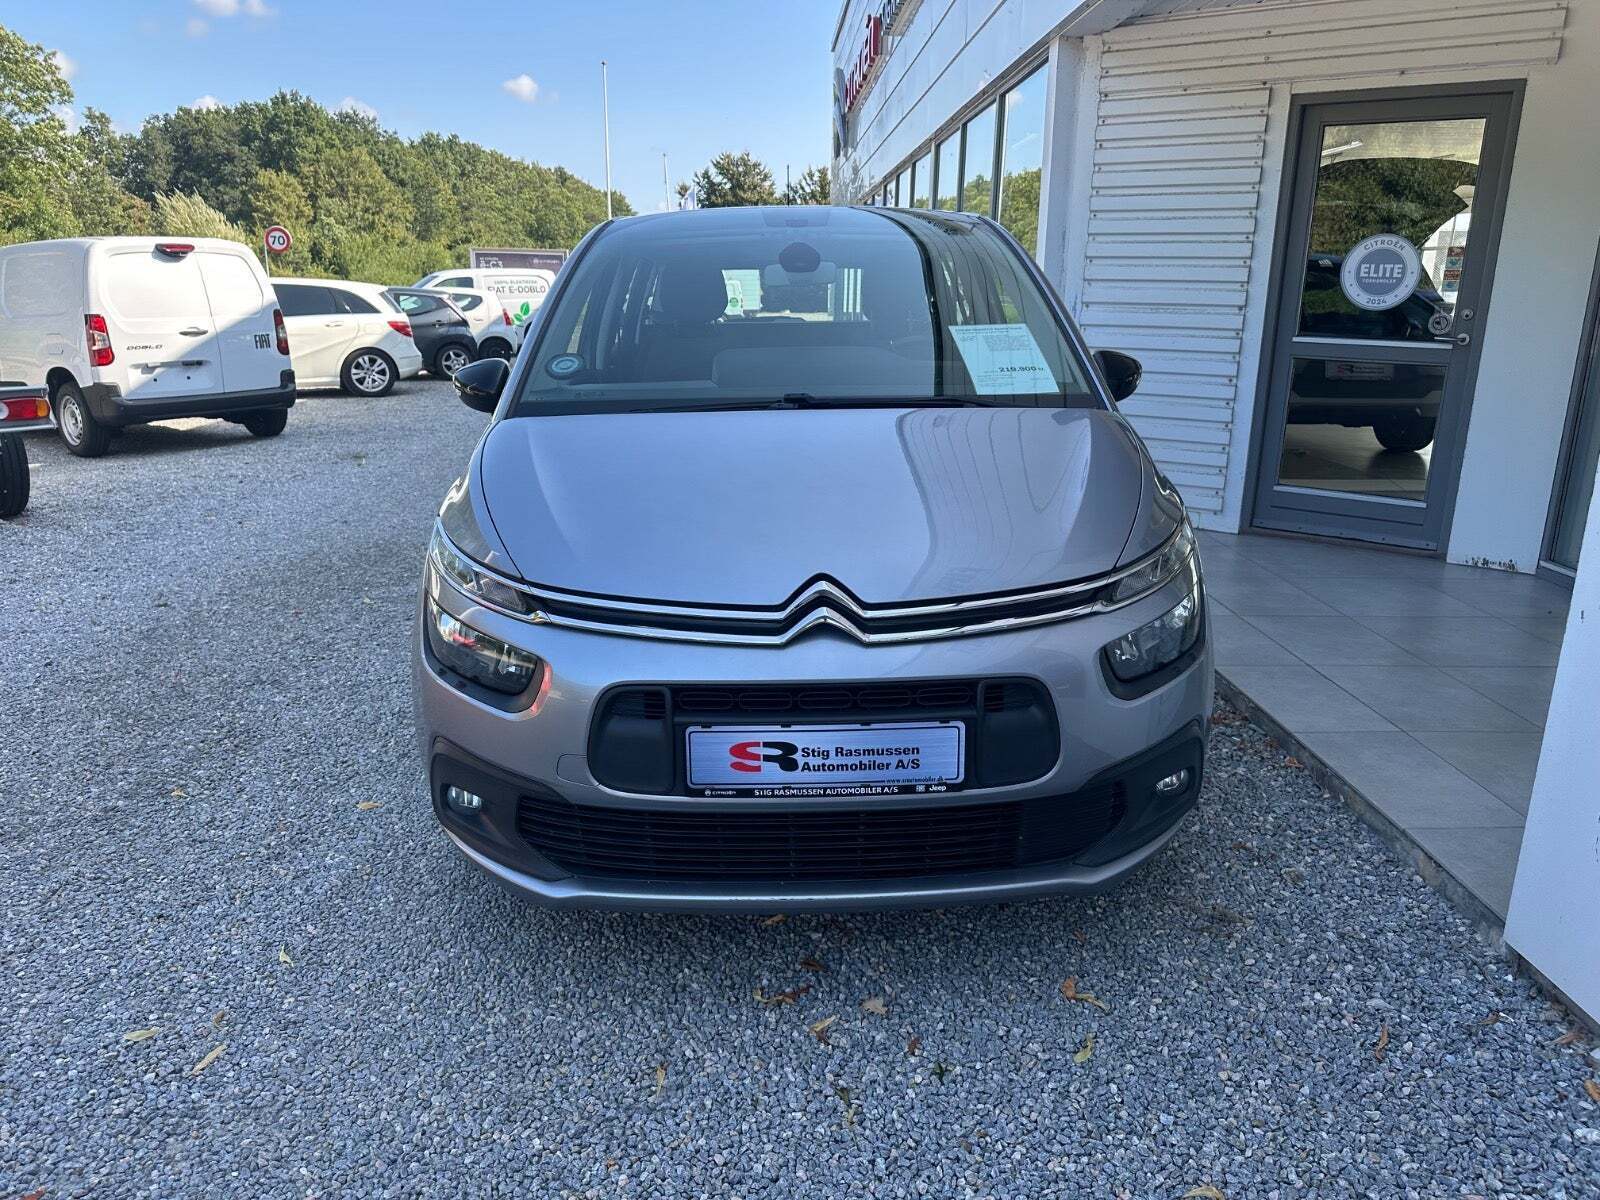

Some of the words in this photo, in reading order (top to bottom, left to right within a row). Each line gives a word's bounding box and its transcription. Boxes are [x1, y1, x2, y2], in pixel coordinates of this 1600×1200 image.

[270, 235, 286, 246] 70
[1363, 239, 1405, 252] CITROËN
[1360, 263, 1403, 278] ELITE
[509, 286, 546, 294] E-DOBLO
[1366, 297, 1388, 305] 2024
[254, 333, 272, 350] FIAT
[801, 747, 830, 760] Stig
[835, 746, 920, 757] Rasmussen
[800, 760, 892, 772] Automobiler
[894, 758, 921, 770] A/S
[774, 788, 824, 796] RASMUSSEN
[825, 787, 882, 795] AUTOMOBILER
